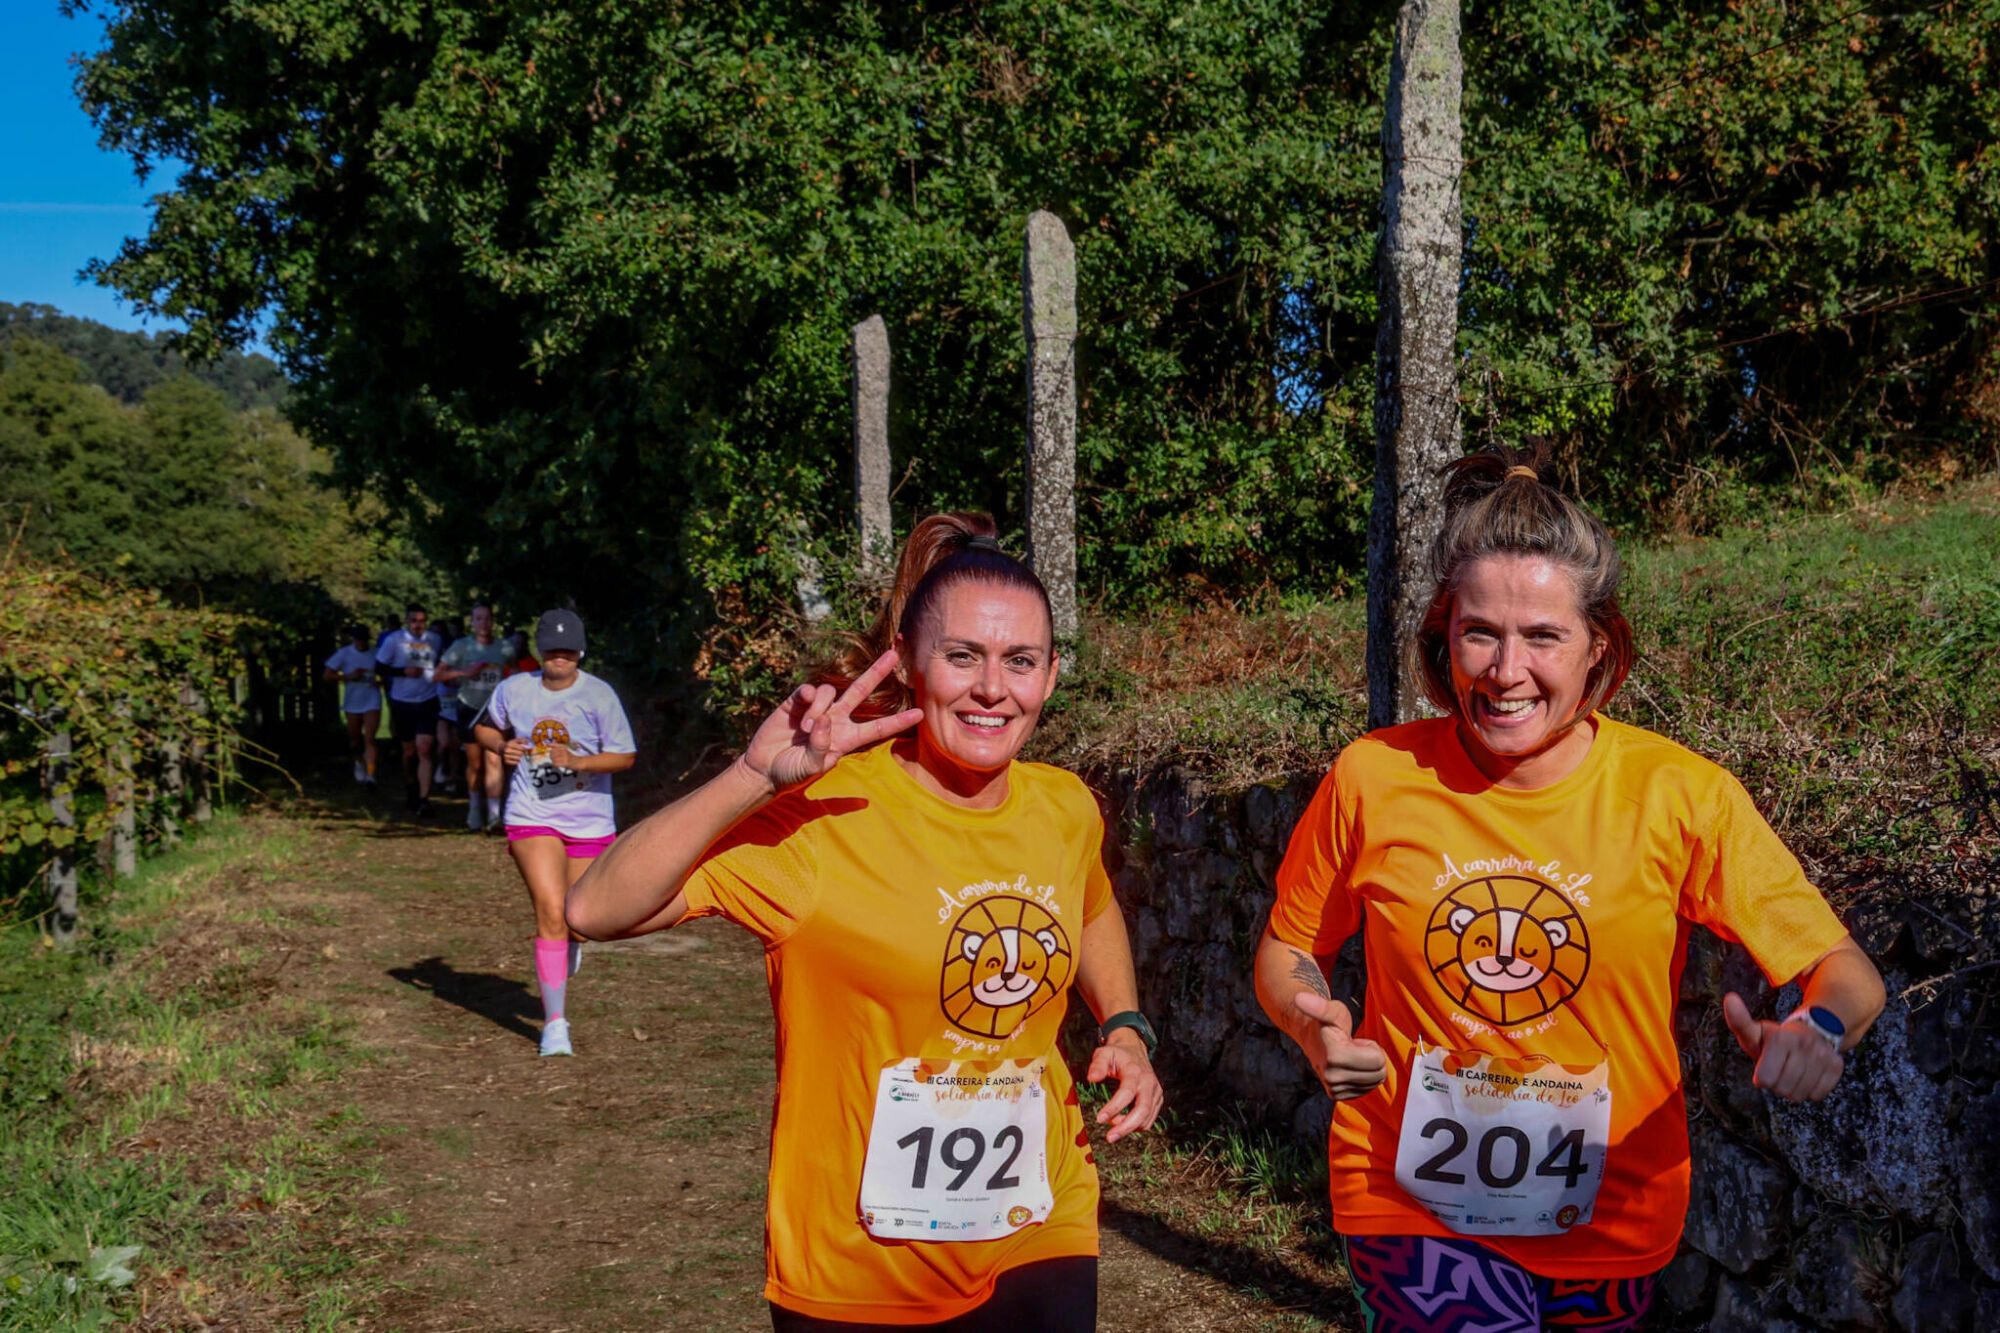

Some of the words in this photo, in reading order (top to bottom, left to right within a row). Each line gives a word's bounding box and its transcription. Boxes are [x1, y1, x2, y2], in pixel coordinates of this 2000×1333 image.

[937, 887, 966, 924] A
[1013, 874, 1033, 896] de
[1432, 853, 1467, 890] A
[1463, 853, 1536, 873] carreira
[1538, 860, 1561, 882] de
[1559, 873, 1592, 907] Leo
[936, 1076, 983, 1086] CARREIRA
[985, 1077, 991, 1086] E
[1465, 1081, 1532, 1101] solidaria
[1536, 1088, 1553, 1102] de
[1558, 1090, 1579, 1108] Leo
[1466, 1070, 1519, 1085] CARREIRA
[1523, 1077, 1529, 1087] E
[1532, 1079, 1583, 1090] ANDAINA
[896, 1124, 1024, 1191] 192
[1414, 1117, 1589, 1189] 204
